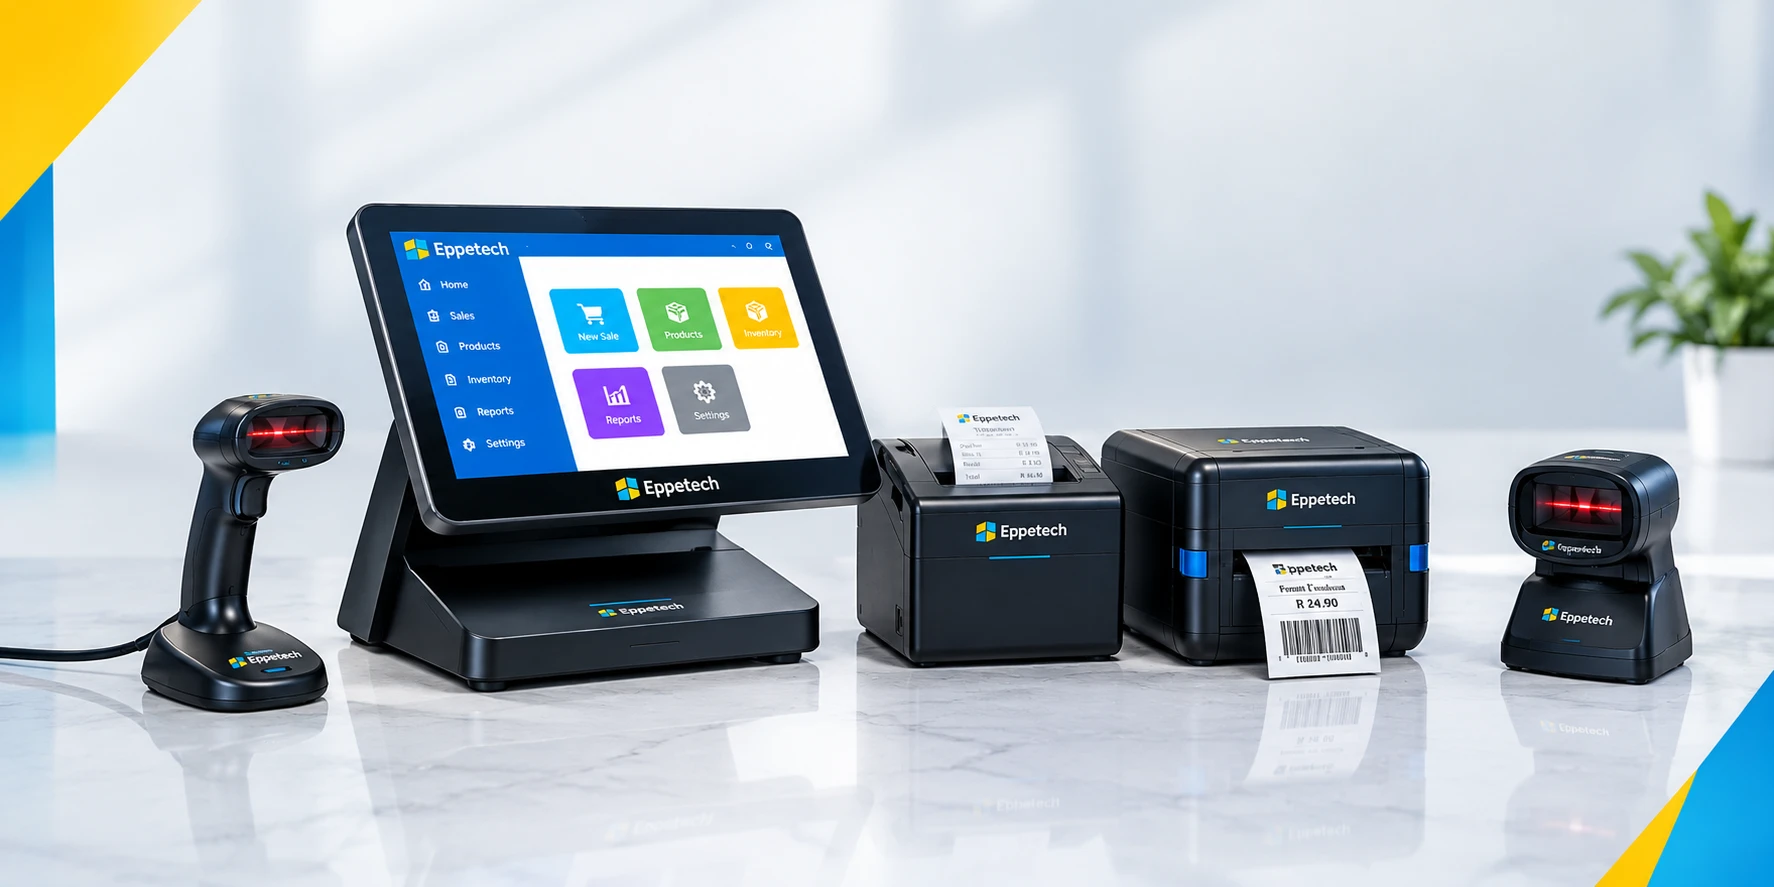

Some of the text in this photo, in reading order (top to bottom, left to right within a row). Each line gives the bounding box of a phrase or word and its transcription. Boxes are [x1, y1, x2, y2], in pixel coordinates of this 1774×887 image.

[433, 242, 510, 259] Eppetech
[440, 280, 469, 289] Home
[450, 311, 475, 320] Sales
[577, 331, 619, 341] New Sale
[664, 330, 704, 340] Products
[743, 328, 782, 339] Inventory
[459, 341, 501, 351] Products
[467, 375, 512, 385] Inventory
[477, 407, 514, 418] Reports
[694, 410, 730, 421] Settings
[606, 414, 642, 426] Reports
[486, 438, 526, 450] Settings
[643, 475, 720, 498] Eppetech
[1291, 492, 1356, 509] Eppetech
[1000, 523, 1067, 541] Eppetech
[618, 602, 685, 616] Eppetech
[1296, 597, 1339, 609] R 24.90
[1560, 611, 1613, 626] Eppetech
[246, 650, 302, 664] Eppetech
